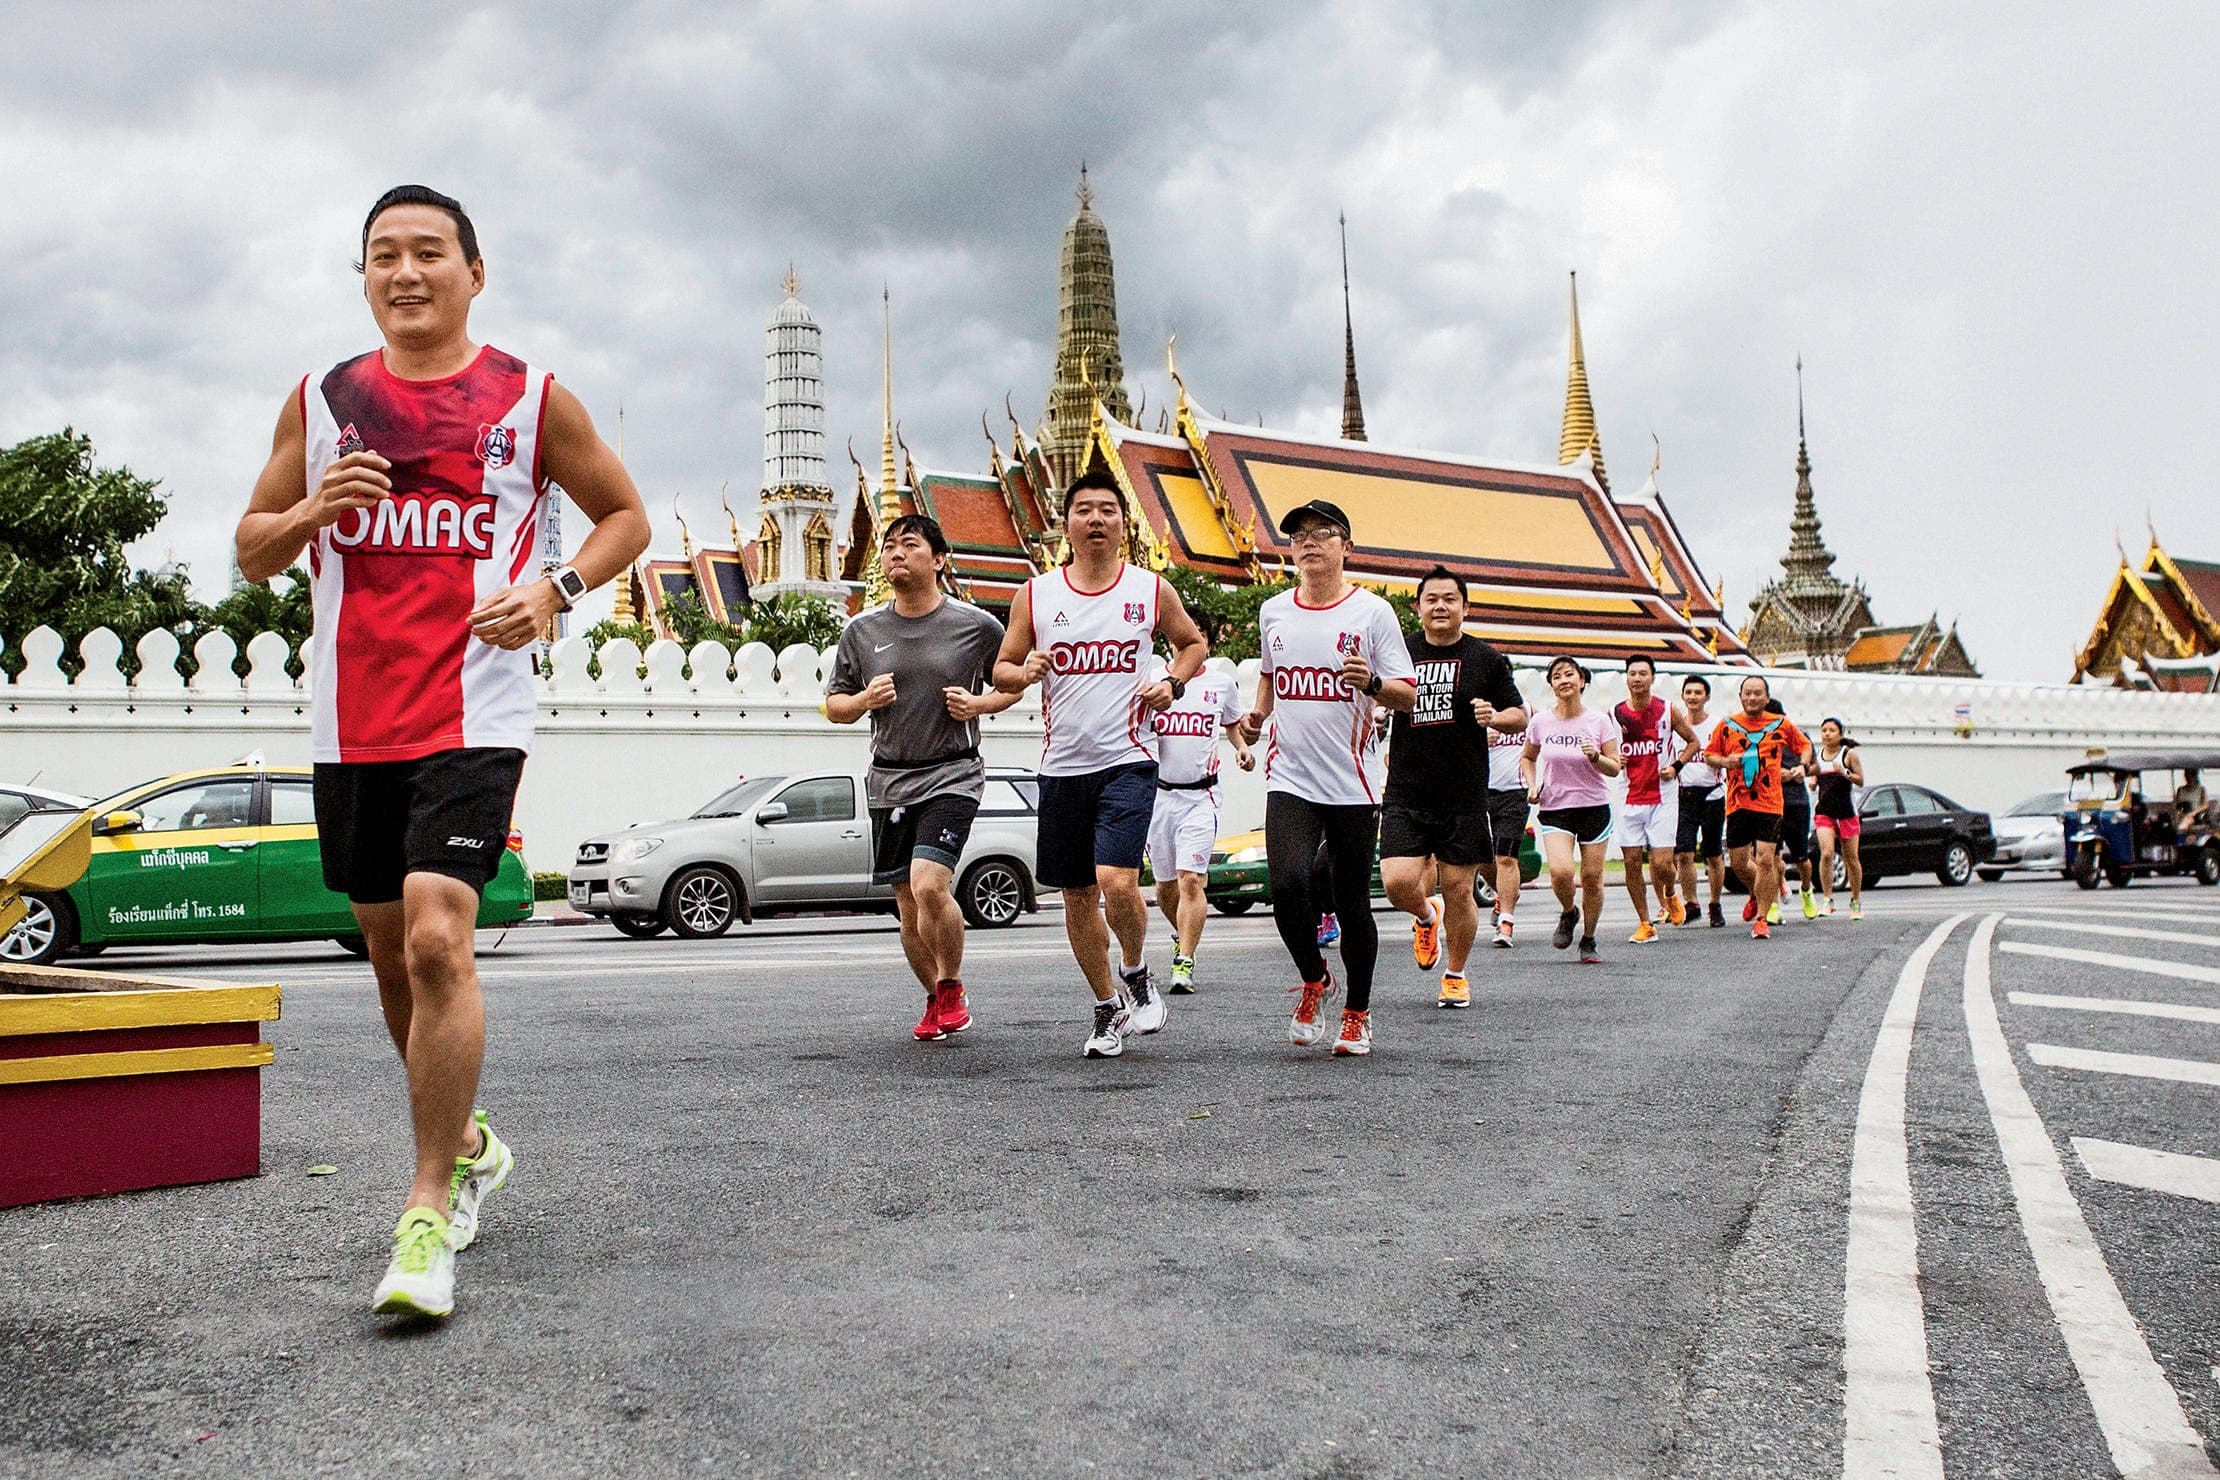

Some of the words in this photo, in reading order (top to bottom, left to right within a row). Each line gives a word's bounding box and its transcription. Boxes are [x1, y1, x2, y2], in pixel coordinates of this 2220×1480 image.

[332, 497, 497, 552] OMAC
[1052, 643, 1138, 673] OMAC
[1415, 662, 1456, 684] RUN
[1275, 669, 1353, 699] OMAC
[1416, 685, 1428, 696] OR
[1430, 683, 1454, 694] YOUR
[1413, 693, 1453, 713] LIVES
[1154, 713, 1214, 735] OMAC
[1413, 709, 1453, 724] THAILAND
[1545, 734, 1586, 748] Kapp
[1621, 740, 1663, 756] OMAC
[446, 836, 485, 849] 2XU
[108, 899, 190, 924] ร้องเรียนแท็กซี่
[191, 901, 217, 919] โทร.
[218, 903, 246, 917] 1584
